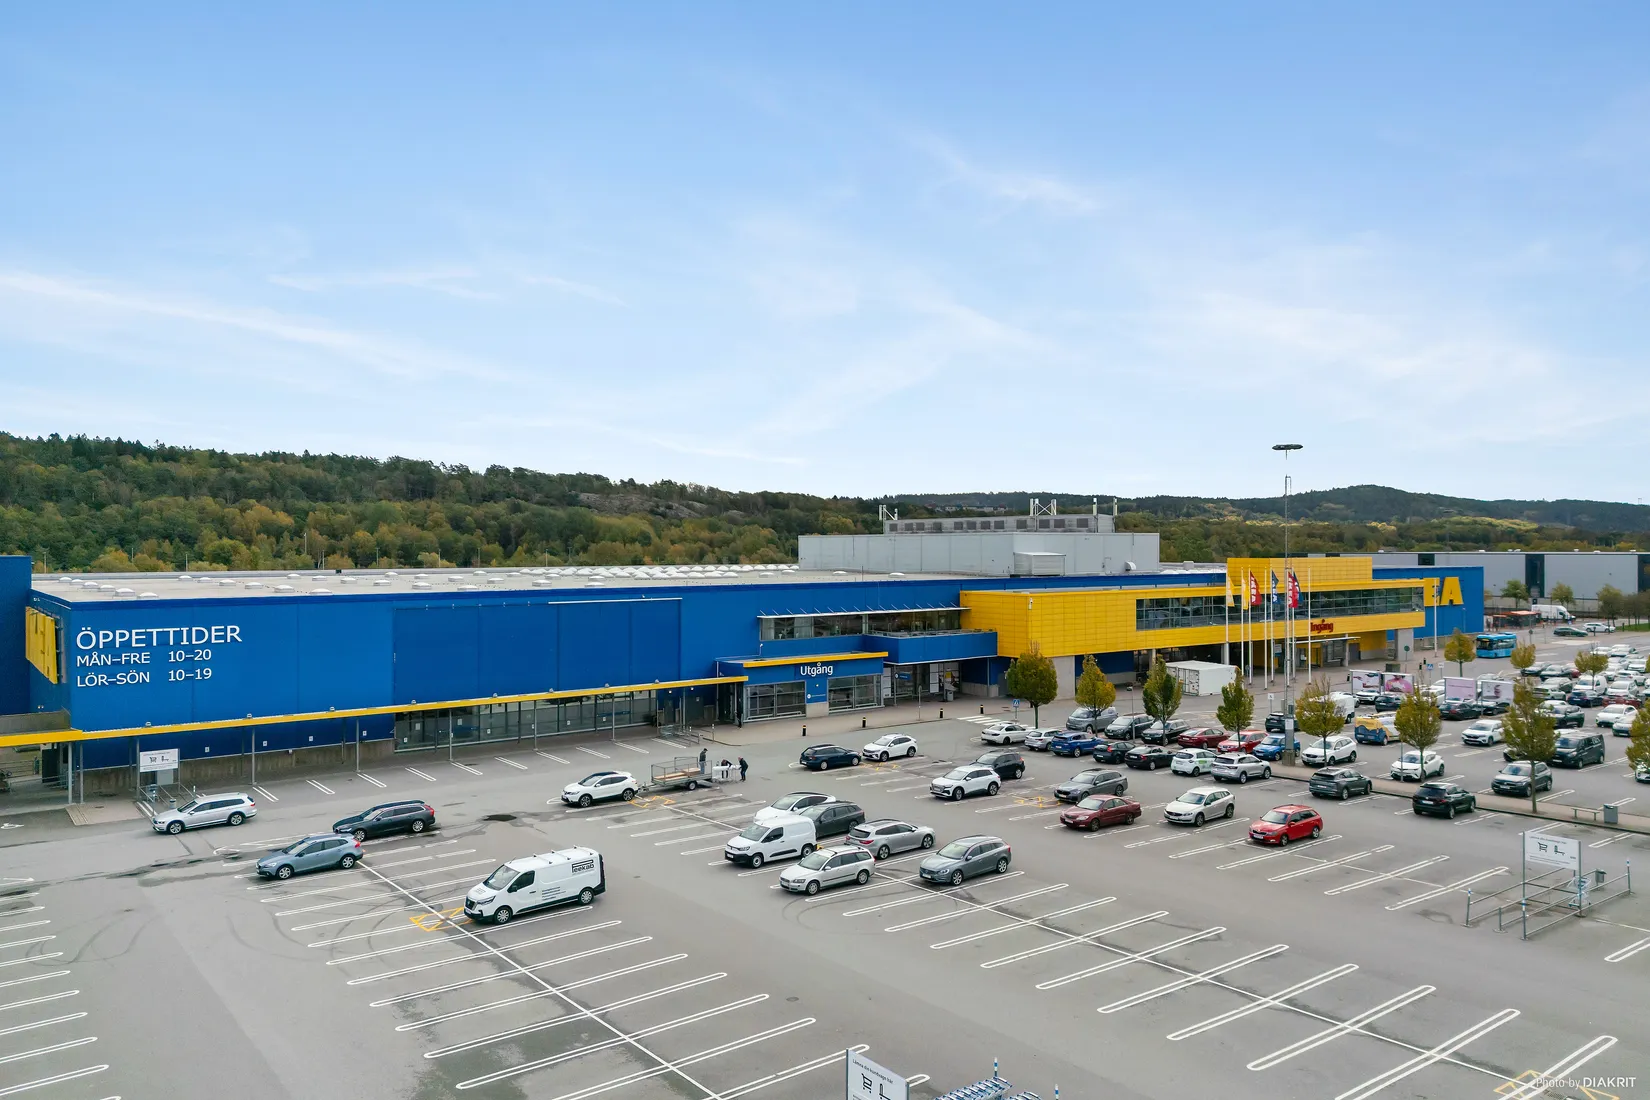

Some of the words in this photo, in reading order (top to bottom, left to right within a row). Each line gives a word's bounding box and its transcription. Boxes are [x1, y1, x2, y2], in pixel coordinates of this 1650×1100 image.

[1310, 619, 1334, 634] Ingång
[76, 625, 242, 650] ÖPPETTIDER
[77, 652, 150, 667] MÅN–FRE
[168, 649, 212, 662] 10–20
[77, 670, 150, 687] LÖR–SÖN
[168, 668, 212, 681] 10–19
[800, 662, 833, 677] Utgång
